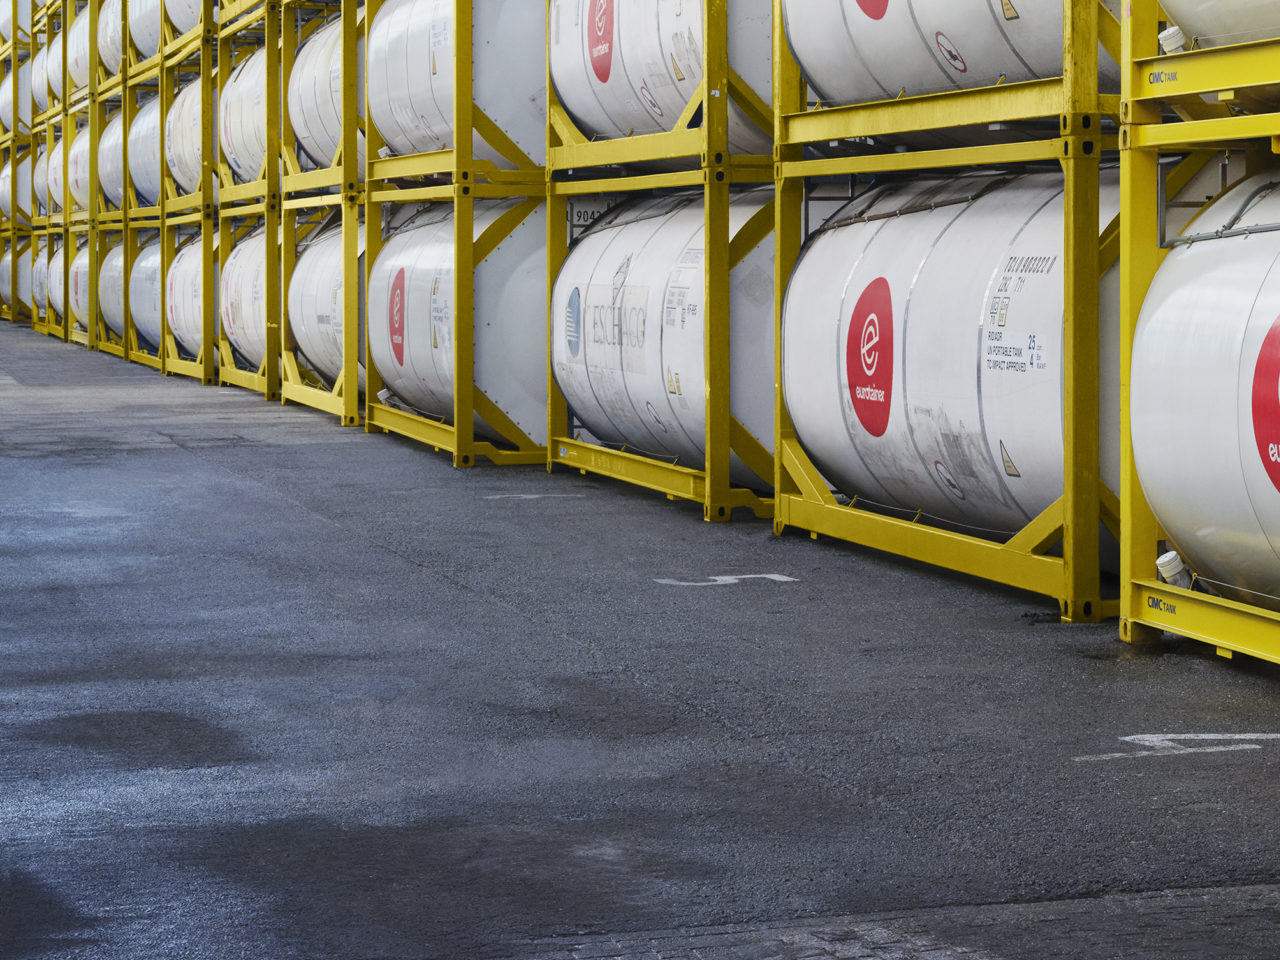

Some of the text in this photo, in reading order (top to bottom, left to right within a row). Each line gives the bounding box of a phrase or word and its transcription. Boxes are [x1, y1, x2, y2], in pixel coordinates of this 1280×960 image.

[1149, 71, 1178, 84] CIMC TANK
[576, 211, 602, 222] 904
[1028, 334, 1036, 350] 25
[856, 384, 885, 403] eurotainer
[1147, 596, 1177, 615] CIMC TANK
